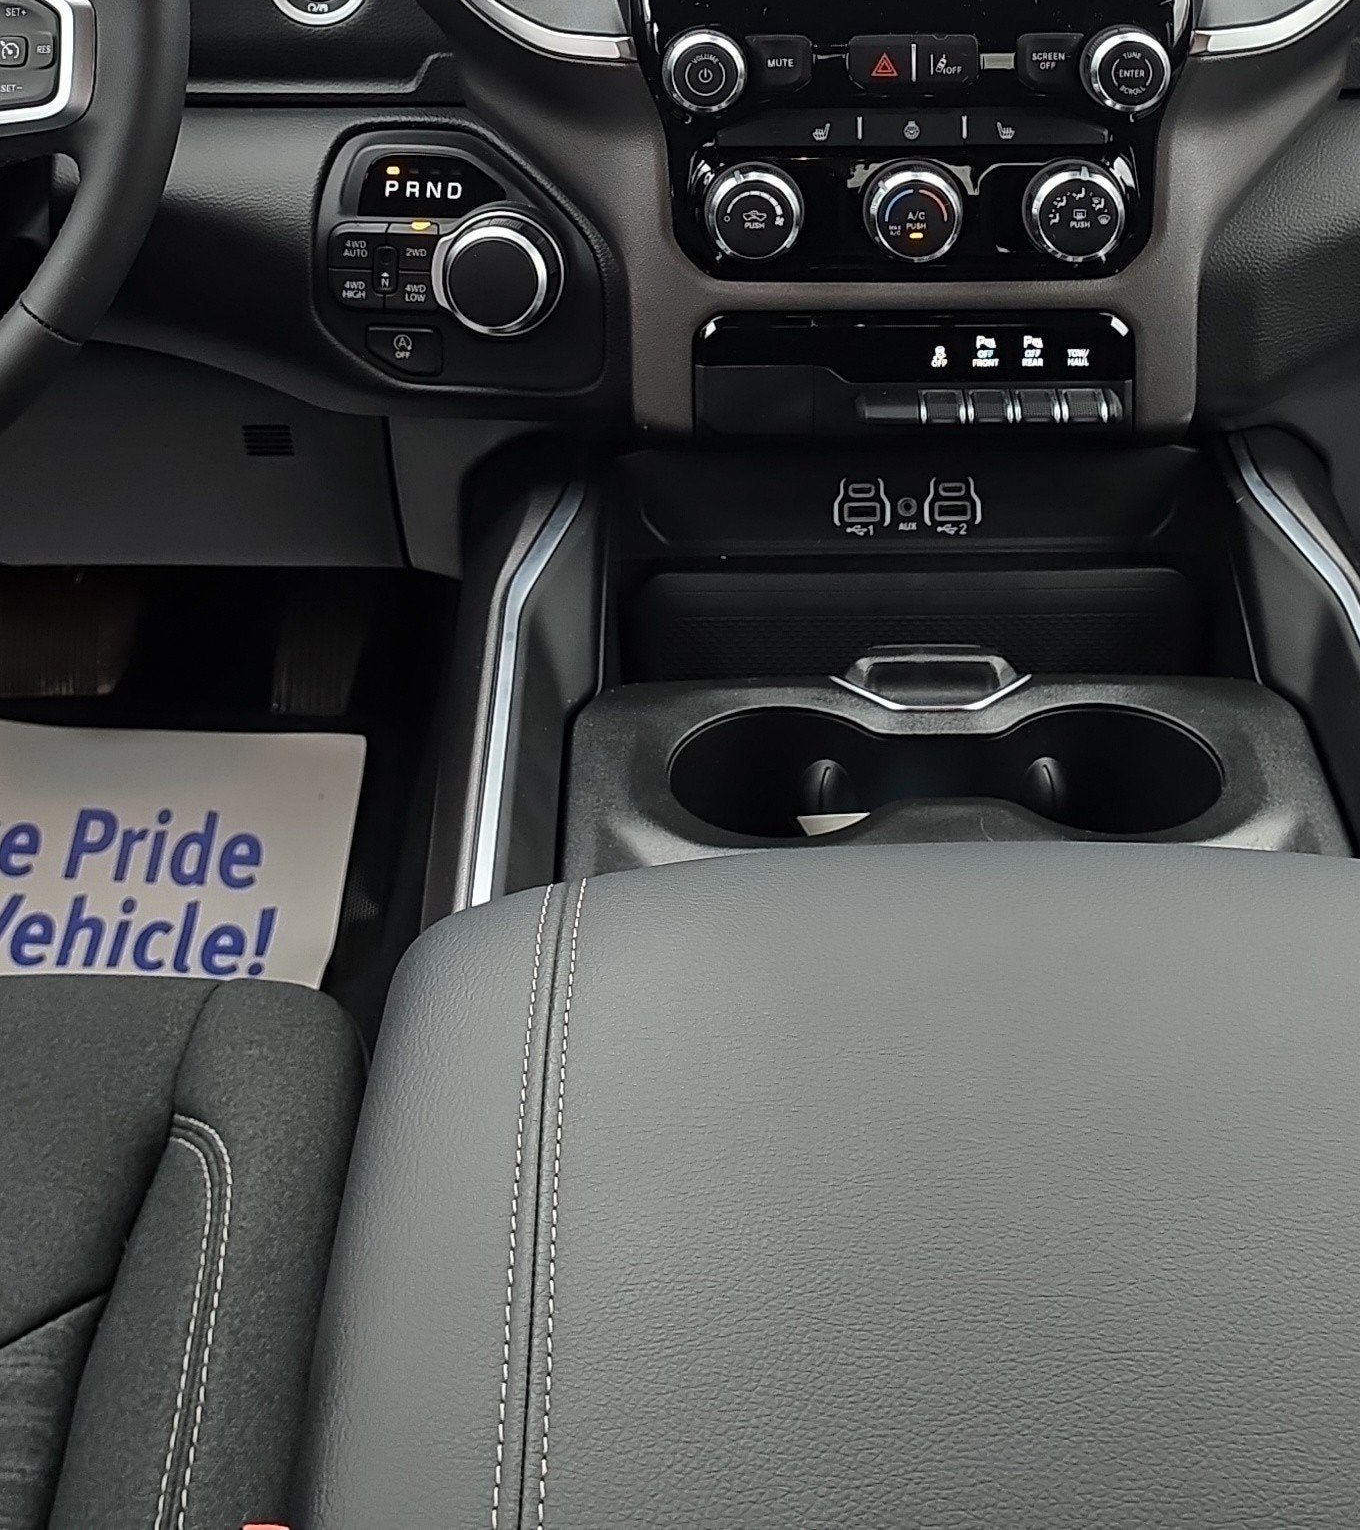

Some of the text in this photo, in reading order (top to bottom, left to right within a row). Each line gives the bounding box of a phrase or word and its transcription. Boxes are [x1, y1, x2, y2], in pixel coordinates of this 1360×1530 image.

[37, 44, 51, 55] RES
[692, 53, 720, 65] VOLUME
[1032, 52, 1065, 61] SCREEN
[1123, 51, 1142, 60] TUNE
[767, 58, 794, 68] MUTE
[1040, 61, 1056, 70] OFF
[1118, 69, 1145, 78] ENTER
[1119, 84, 1146, 95] SCROLL
[907, 211, 926, 220] A/C
[744, 222, 765, 230] PUSH
[906, 222, 927, 230] PUSH
[1070, 221, 1091, 229] PUSH
[345, 239, 367, 248] 4WD
[343, 248, 368, 258] AUTO
[405, 248, 427, 257] 2WD
[344, 281, 366, 289] 4WD
[381, 278, 389, 287] N
[404, 284, 427, 293] 4WD
[342, 289, 366, 299] HIGH
[404, 293, 426, 303] LOW
[395, 351, 411, 359] OFF
[972, 358, 1000, 367] FRONT
[1021, 357, 1044, 367] REAR
[1067, 358, 1090, 367] HAUL
[898, 522, 917, 531] AUX
[959, 523, 968, 535] 2
[64, 808, 265, 891] Pride
